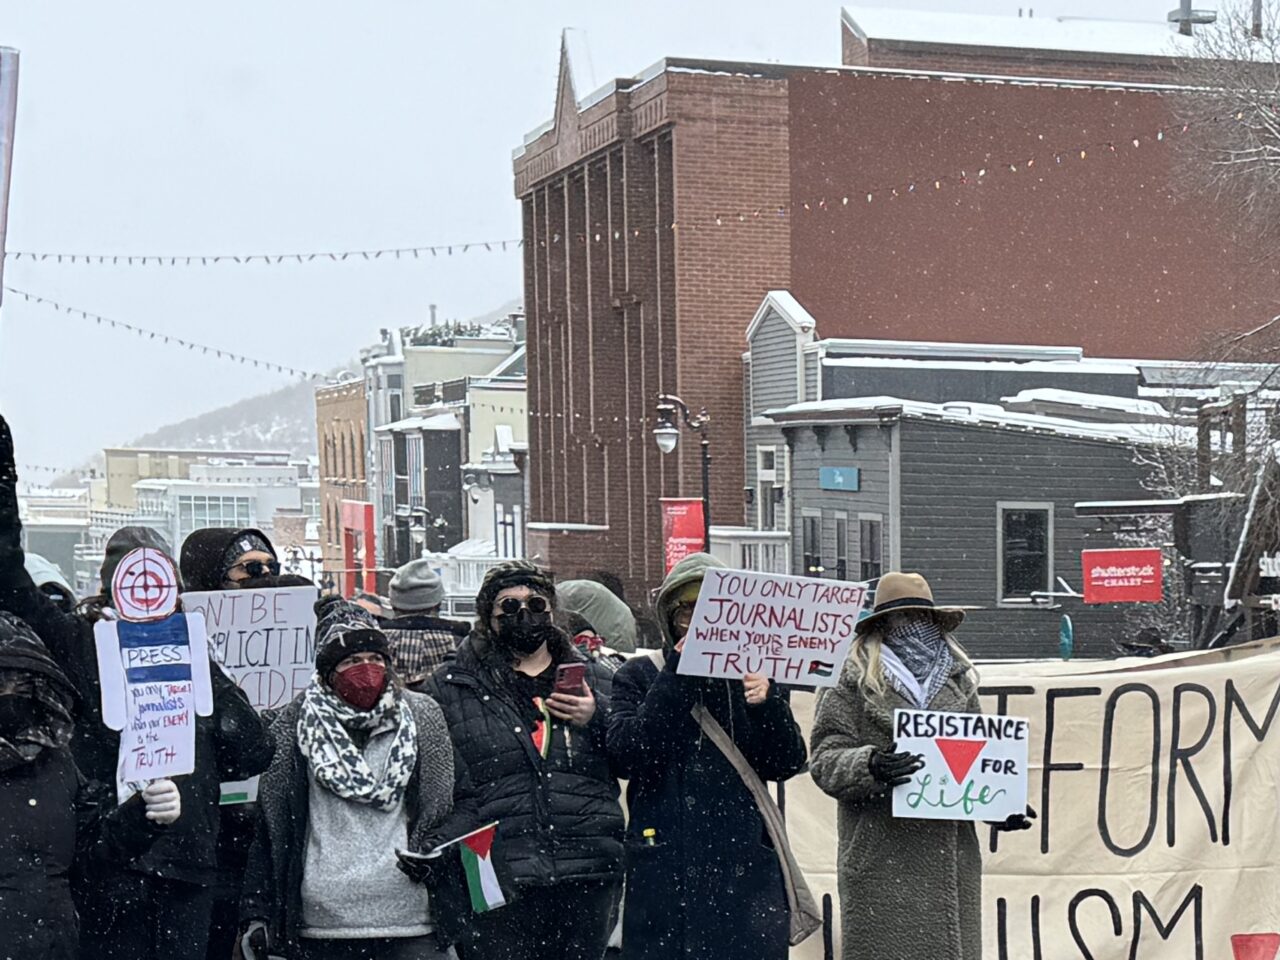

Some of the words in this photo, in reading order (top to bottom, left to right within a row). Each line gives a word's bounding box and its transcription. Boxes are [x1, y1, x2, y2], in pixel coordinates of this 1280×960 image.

[716, 572, 756, 598] YOU
[760, 580, 808, 600] ONLY
[808, 583, 865, 607] TARGET
[250, 593, 291, 624] BE
[704, 598, 853, 638] JOURNALISTS
[695, 627, 740, 642] WHEN
[787, 635, 841, 654] ENEMY
[128, 646, 182, 668] PRESS
[701, 652, 804, 680] TRUTH
[163, 709, 188, 728] ENEMY
[897, 712, 1025, 740] RESISTANCE
[132, 746, 176, 770] TRUTH
[981, 758, 1018, 775] FOR
[906, 773, 1007, 815] Life
